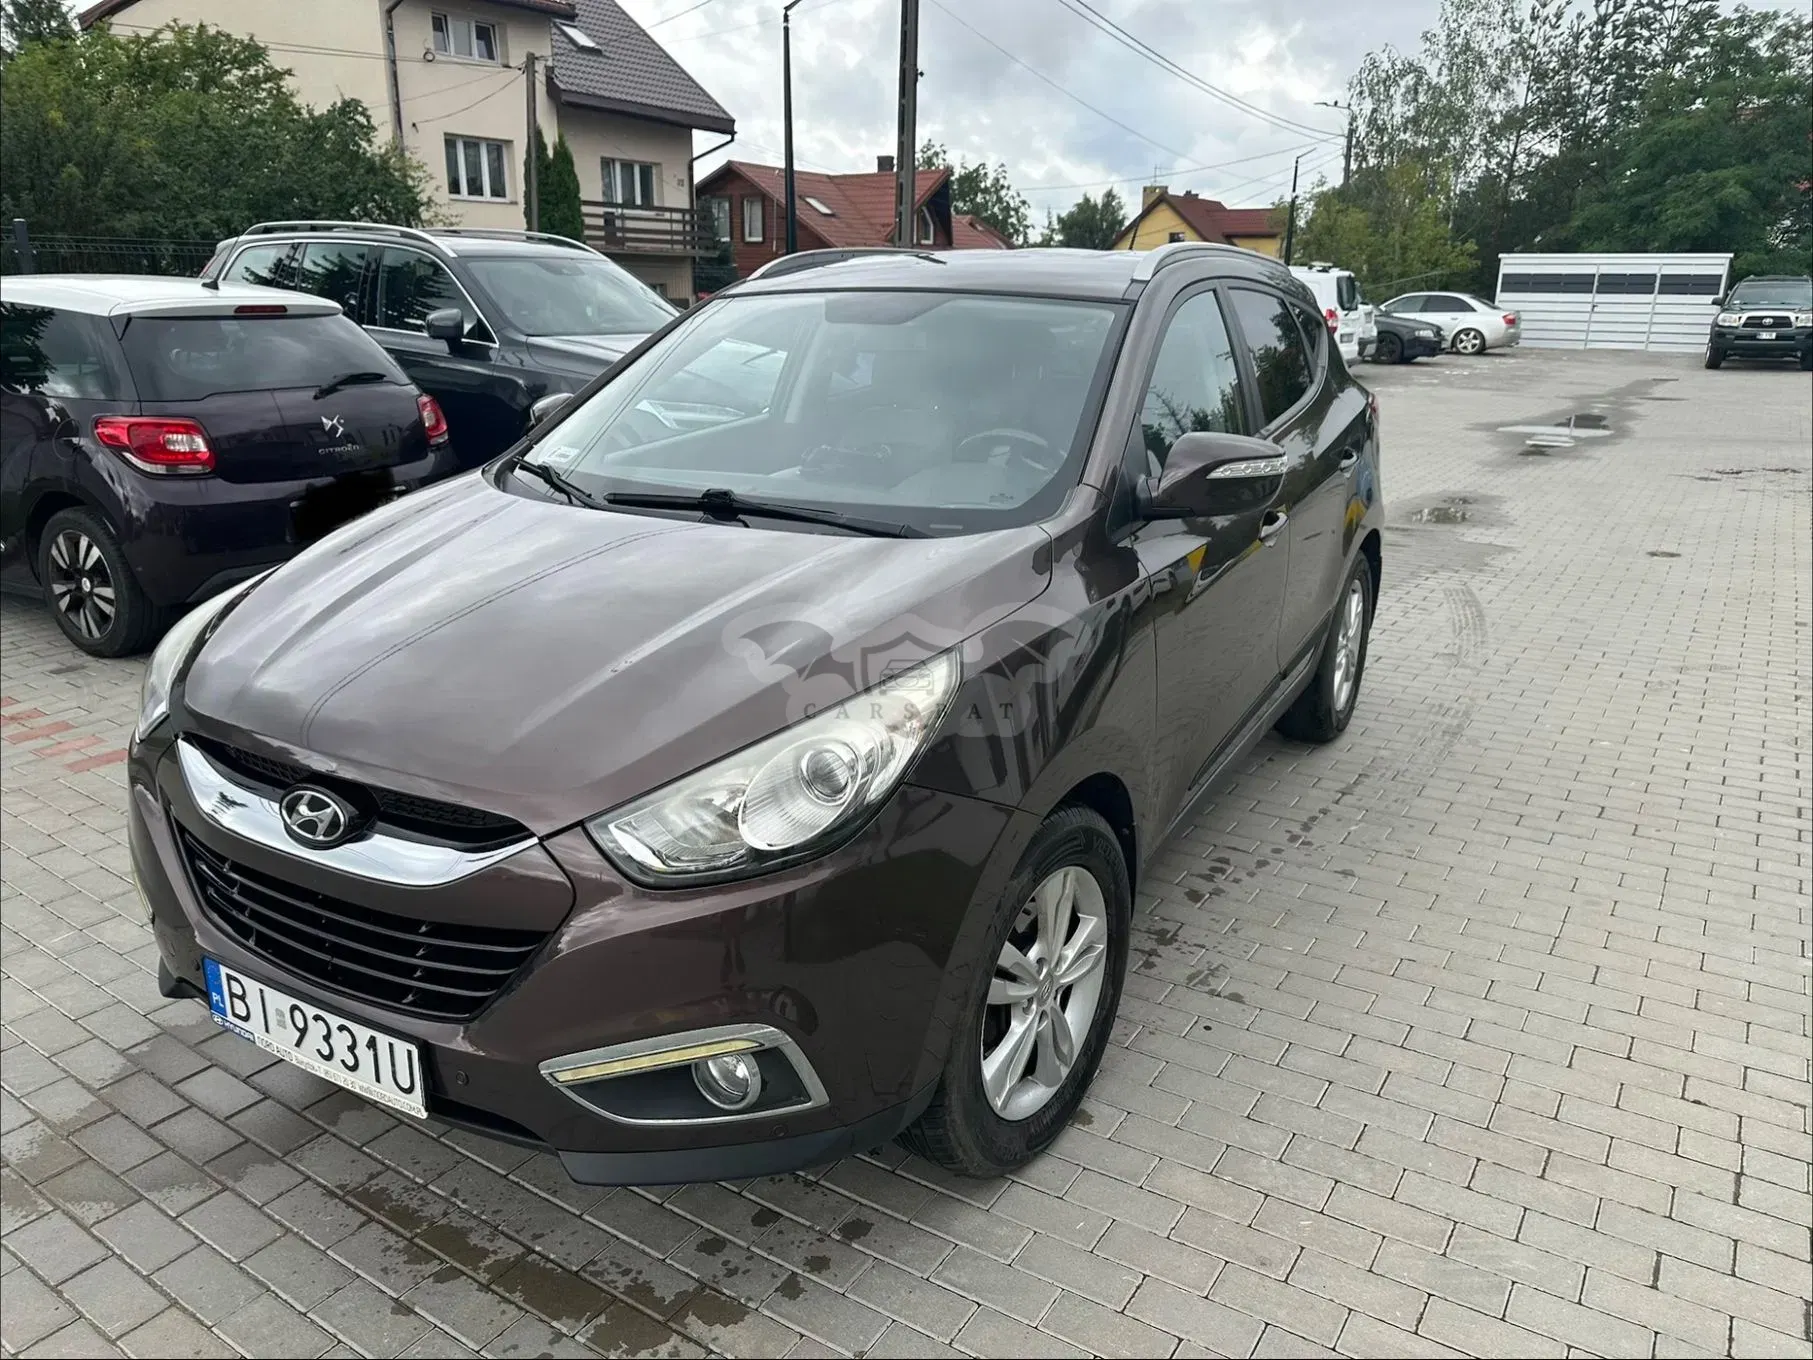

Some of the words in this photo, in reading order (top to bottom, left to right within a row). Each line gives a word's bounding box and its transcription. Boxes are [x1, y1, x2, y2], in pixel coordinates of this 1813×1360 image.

[211, 992, 225, 1009] PL
[225, 972, 271, 1034] BI
[288, 1003, 416, 1095] 9331U
